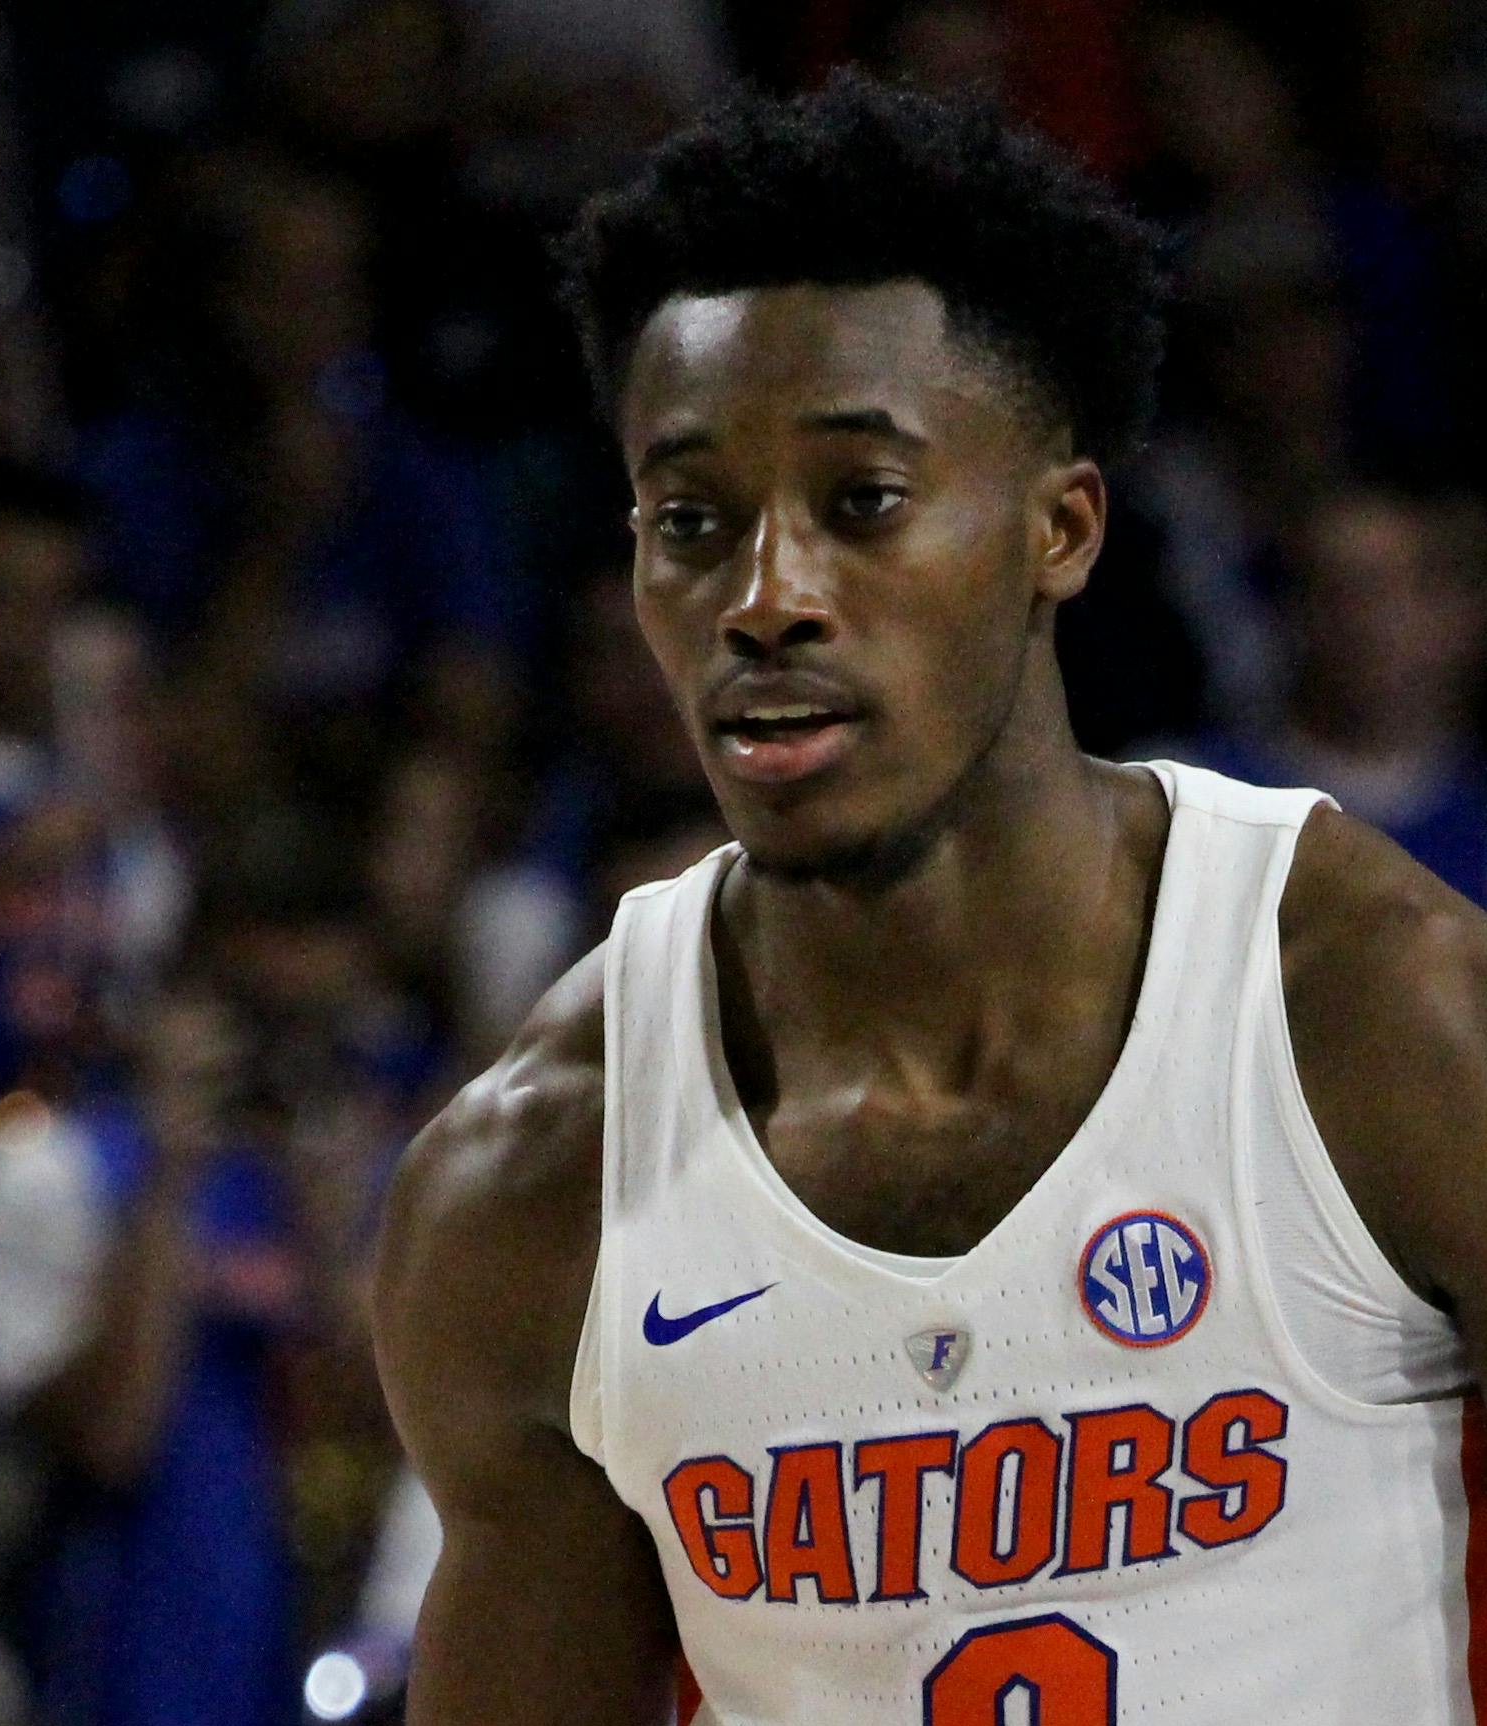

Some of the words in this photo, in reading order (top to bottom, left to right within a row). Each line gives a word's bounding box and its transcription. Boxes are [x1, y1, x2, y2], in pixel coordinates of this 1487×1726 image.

[1089, 1222, 1199, 1336] SEC
[930, 1333, 957, 1371] F
[662, 1387, 1289, 1605] GATORS
